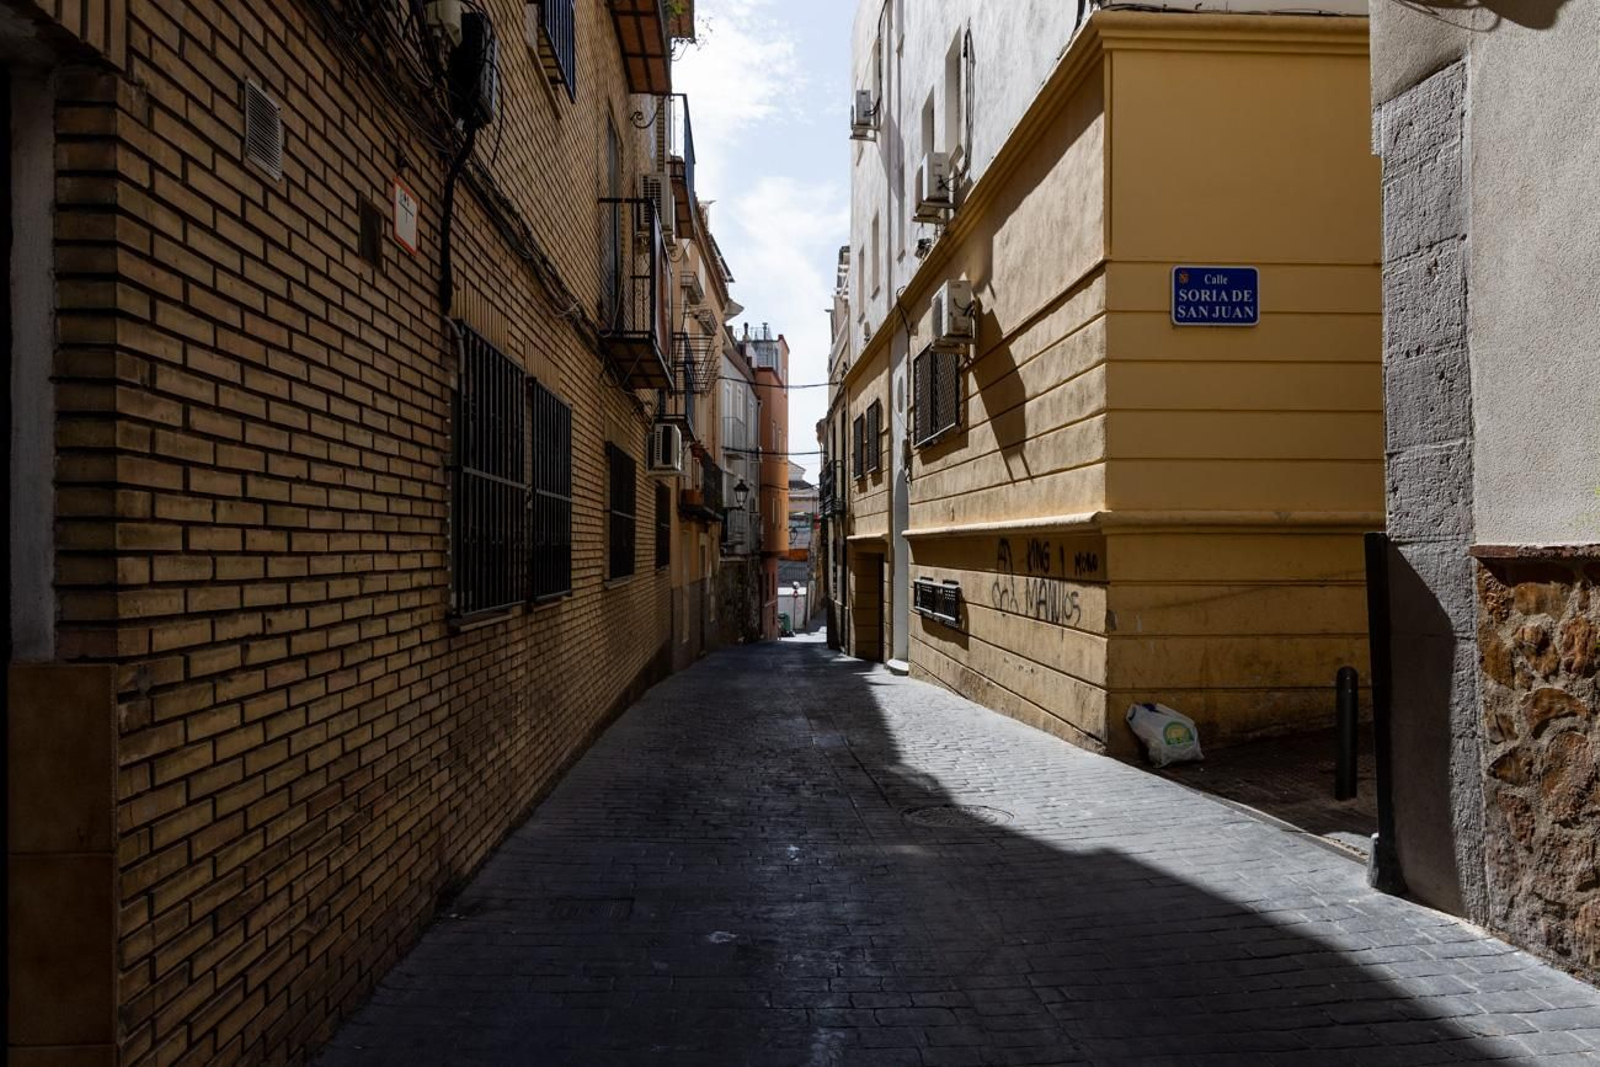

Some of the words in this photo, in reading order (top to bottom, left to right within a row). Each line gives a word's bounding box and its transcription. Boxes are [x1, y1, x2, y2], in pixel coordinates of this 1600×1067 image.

[1204, 274, 1228, 285] Calle
[1179, 289, 1228, 302] SORIA
[1232, 289, 1253, 302] DE
[1177, 305, 1209, 318] SAN
[1212, 306, 1254, 318] JUAN
